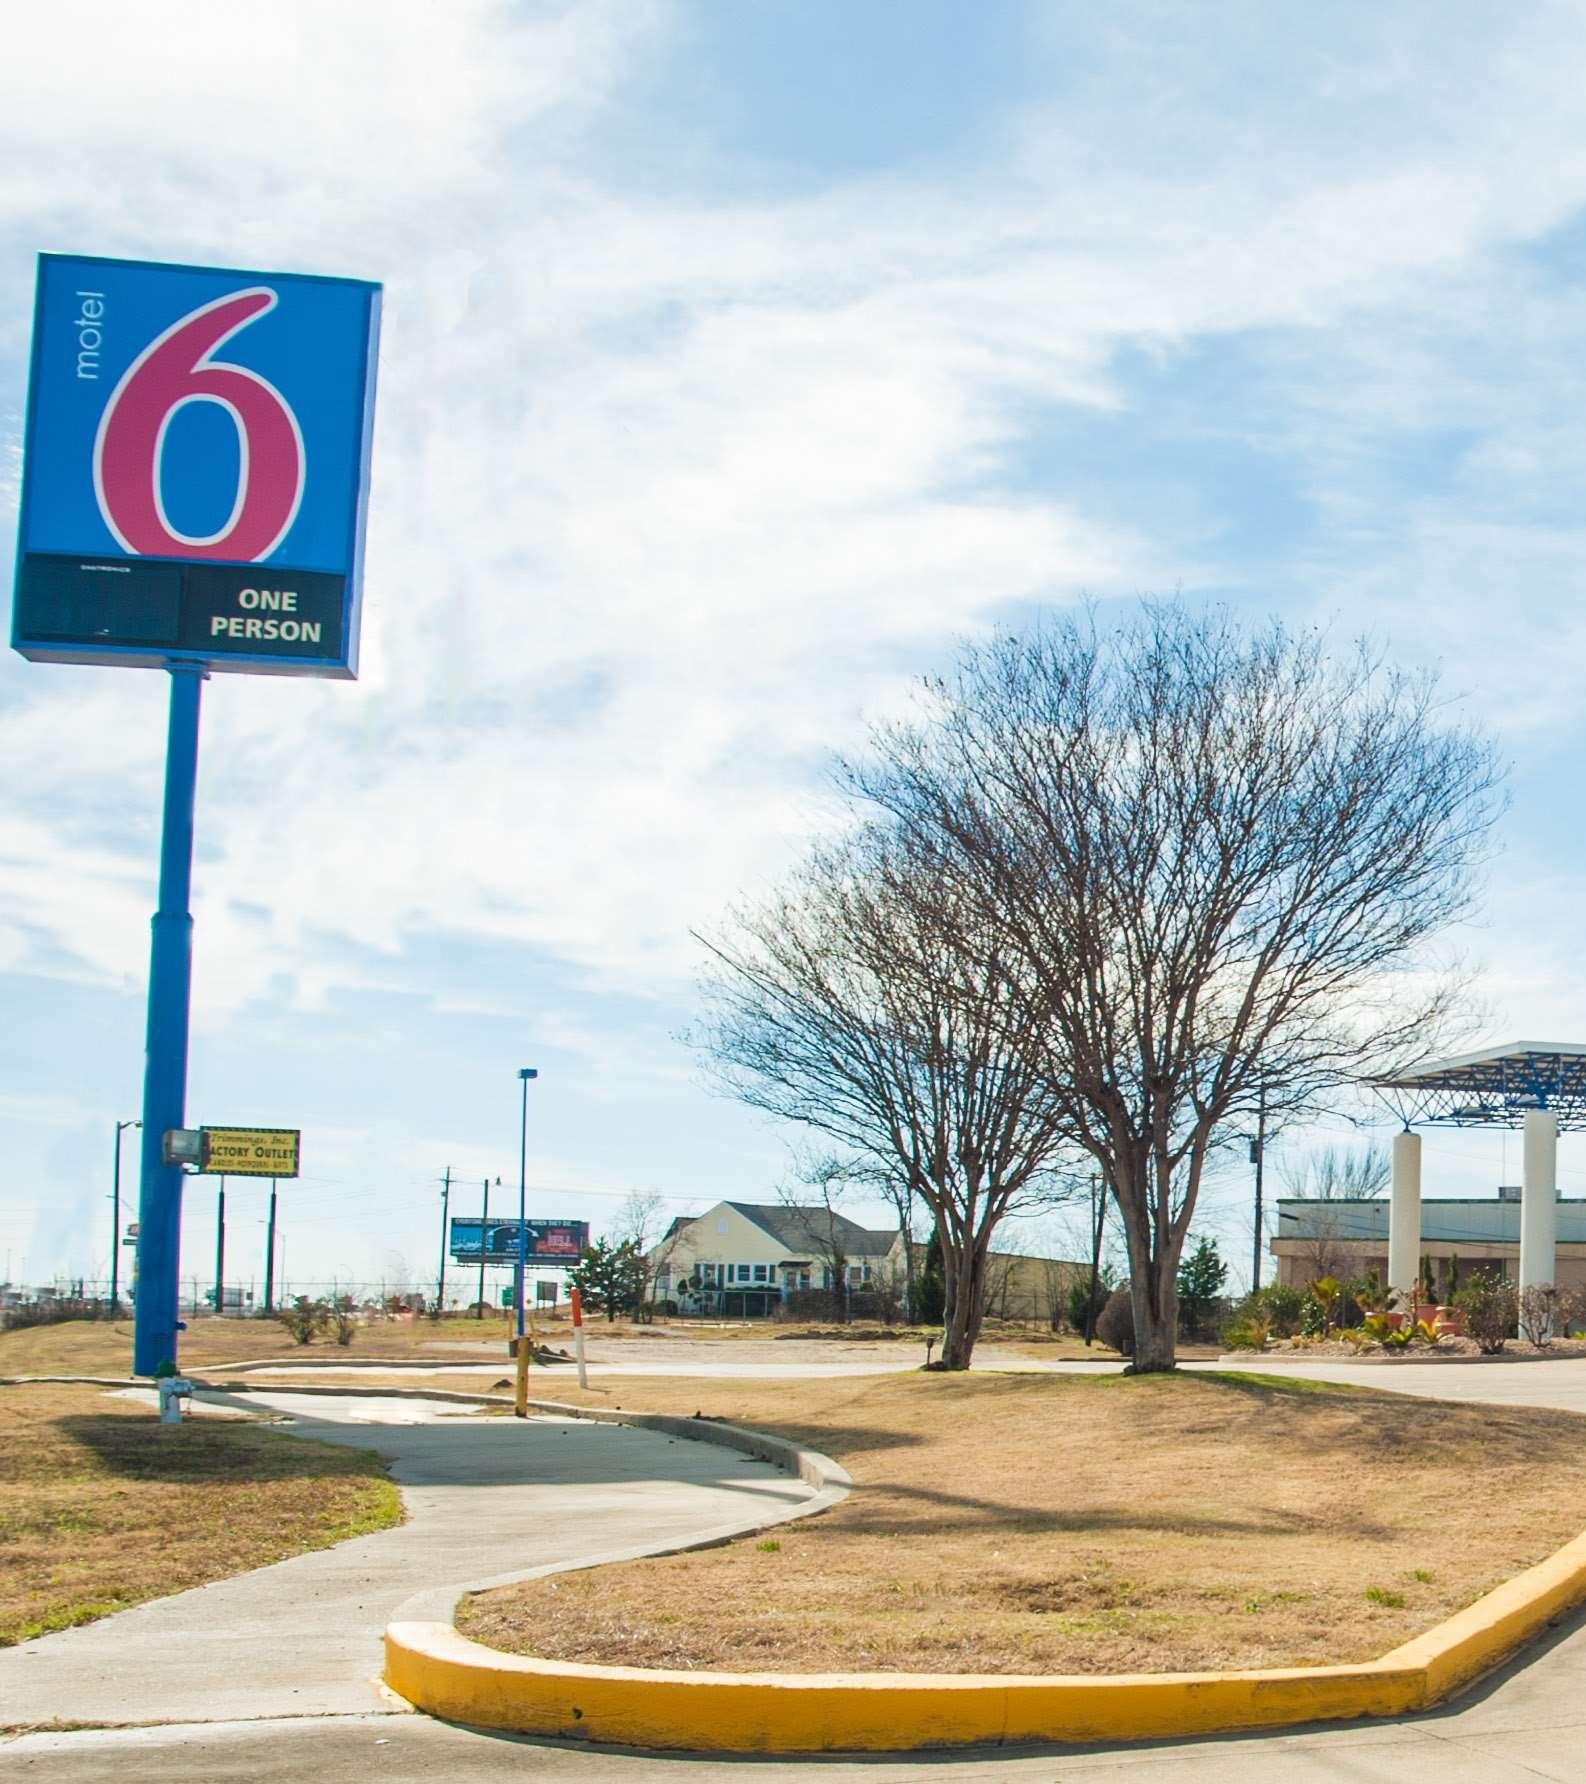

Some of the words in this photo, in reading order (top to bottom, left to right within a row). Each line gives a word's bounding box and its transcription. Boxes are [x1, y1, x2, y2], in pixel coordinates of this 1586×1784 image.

[76, 290, 106, 380] motel
[92, 286, 306, 563] 6
[239, 588, 298, 612] ONE
[210, 616, 321, 643] PERSON
[210, 1146, 249, 1157] ACTORY
[255, 1146, 294, 1159] OUTLET
